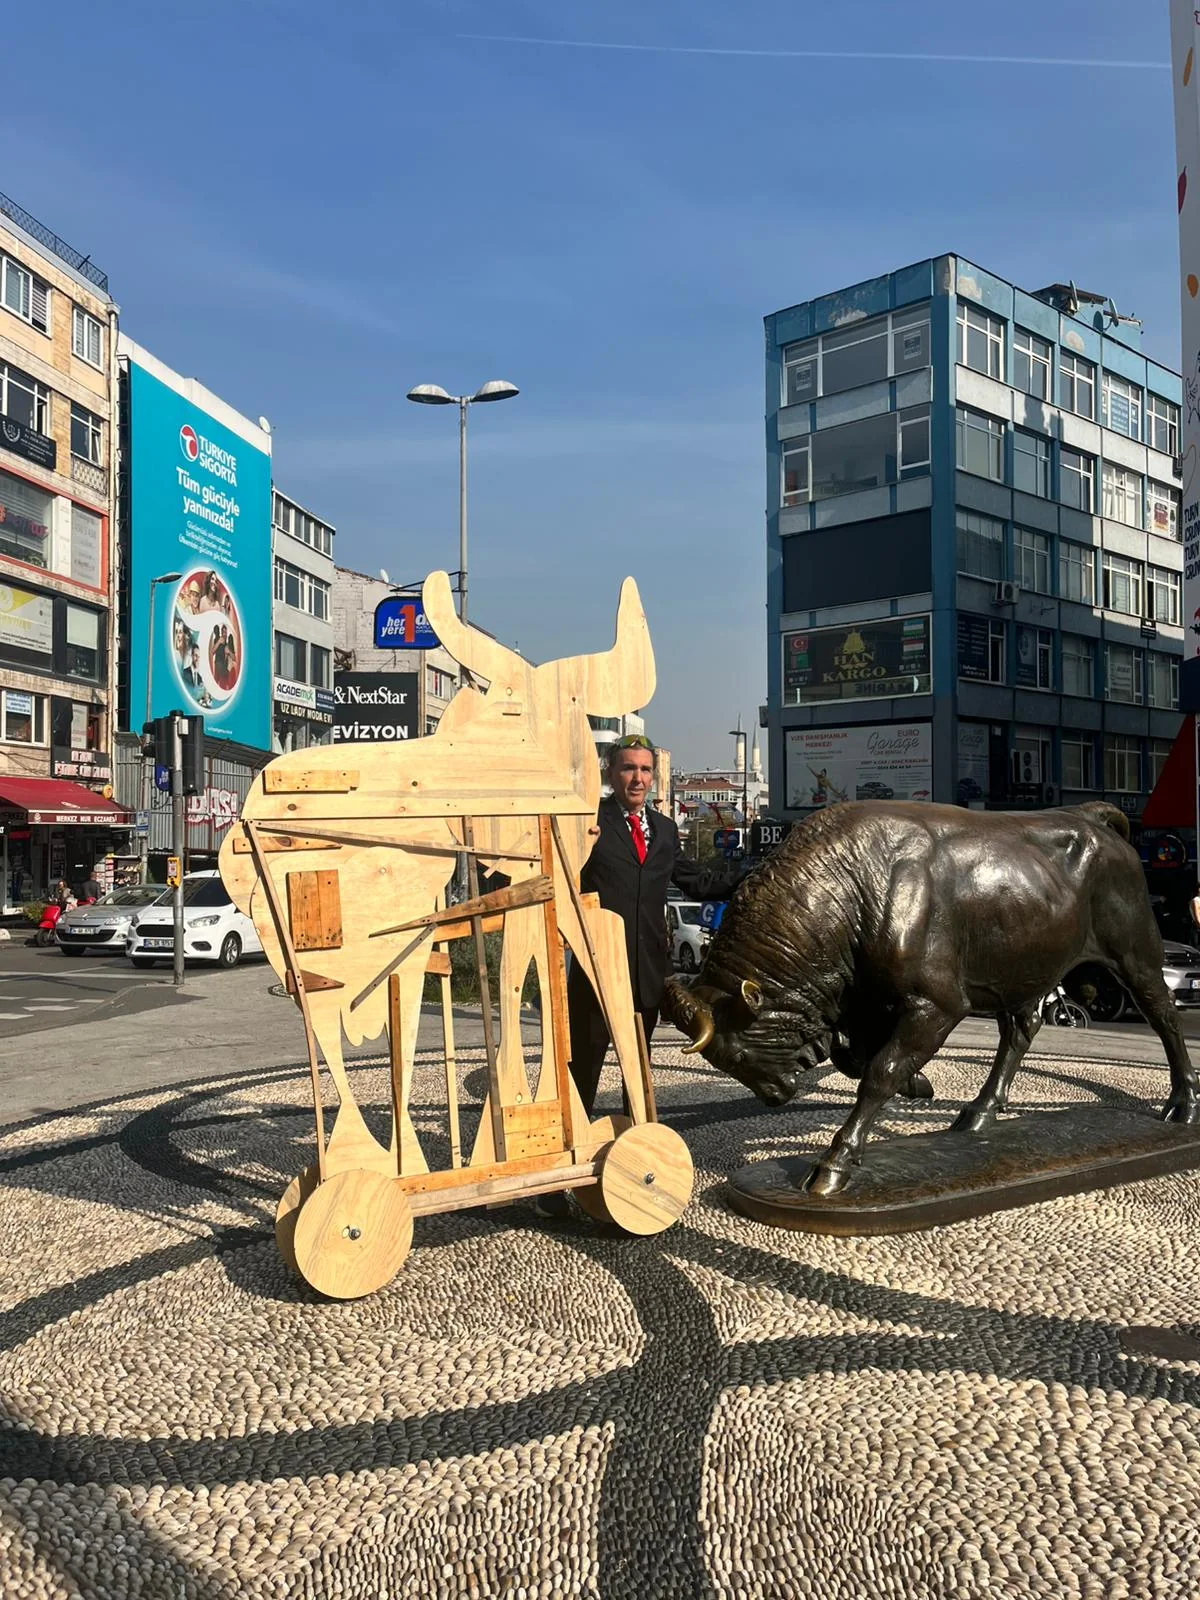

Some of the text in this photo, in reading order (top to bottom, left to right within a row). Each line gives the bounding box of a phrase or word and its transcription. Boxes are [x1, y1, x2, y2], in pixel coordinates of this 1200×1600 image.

[176, 466, 240, 516] Tüm gücüyle
[184, 496, 234, 533] yanınızda!
[387, 616, 405, 626] her
[400, 604, 416, 642] 1
[381, 627, 404, 637] yere
[832, 651, 876, 666] HAN
[823, 666, 886, 682] KARGO
[334, 686, 347, 704] &
[347, 686, 408, 704] NextStar
[290, 705, 305, 718] LADY
[307, 709, 323, 722] MODA
[898, 729, 920, 737] EURO
[867, 732, 920, 754] Garage
